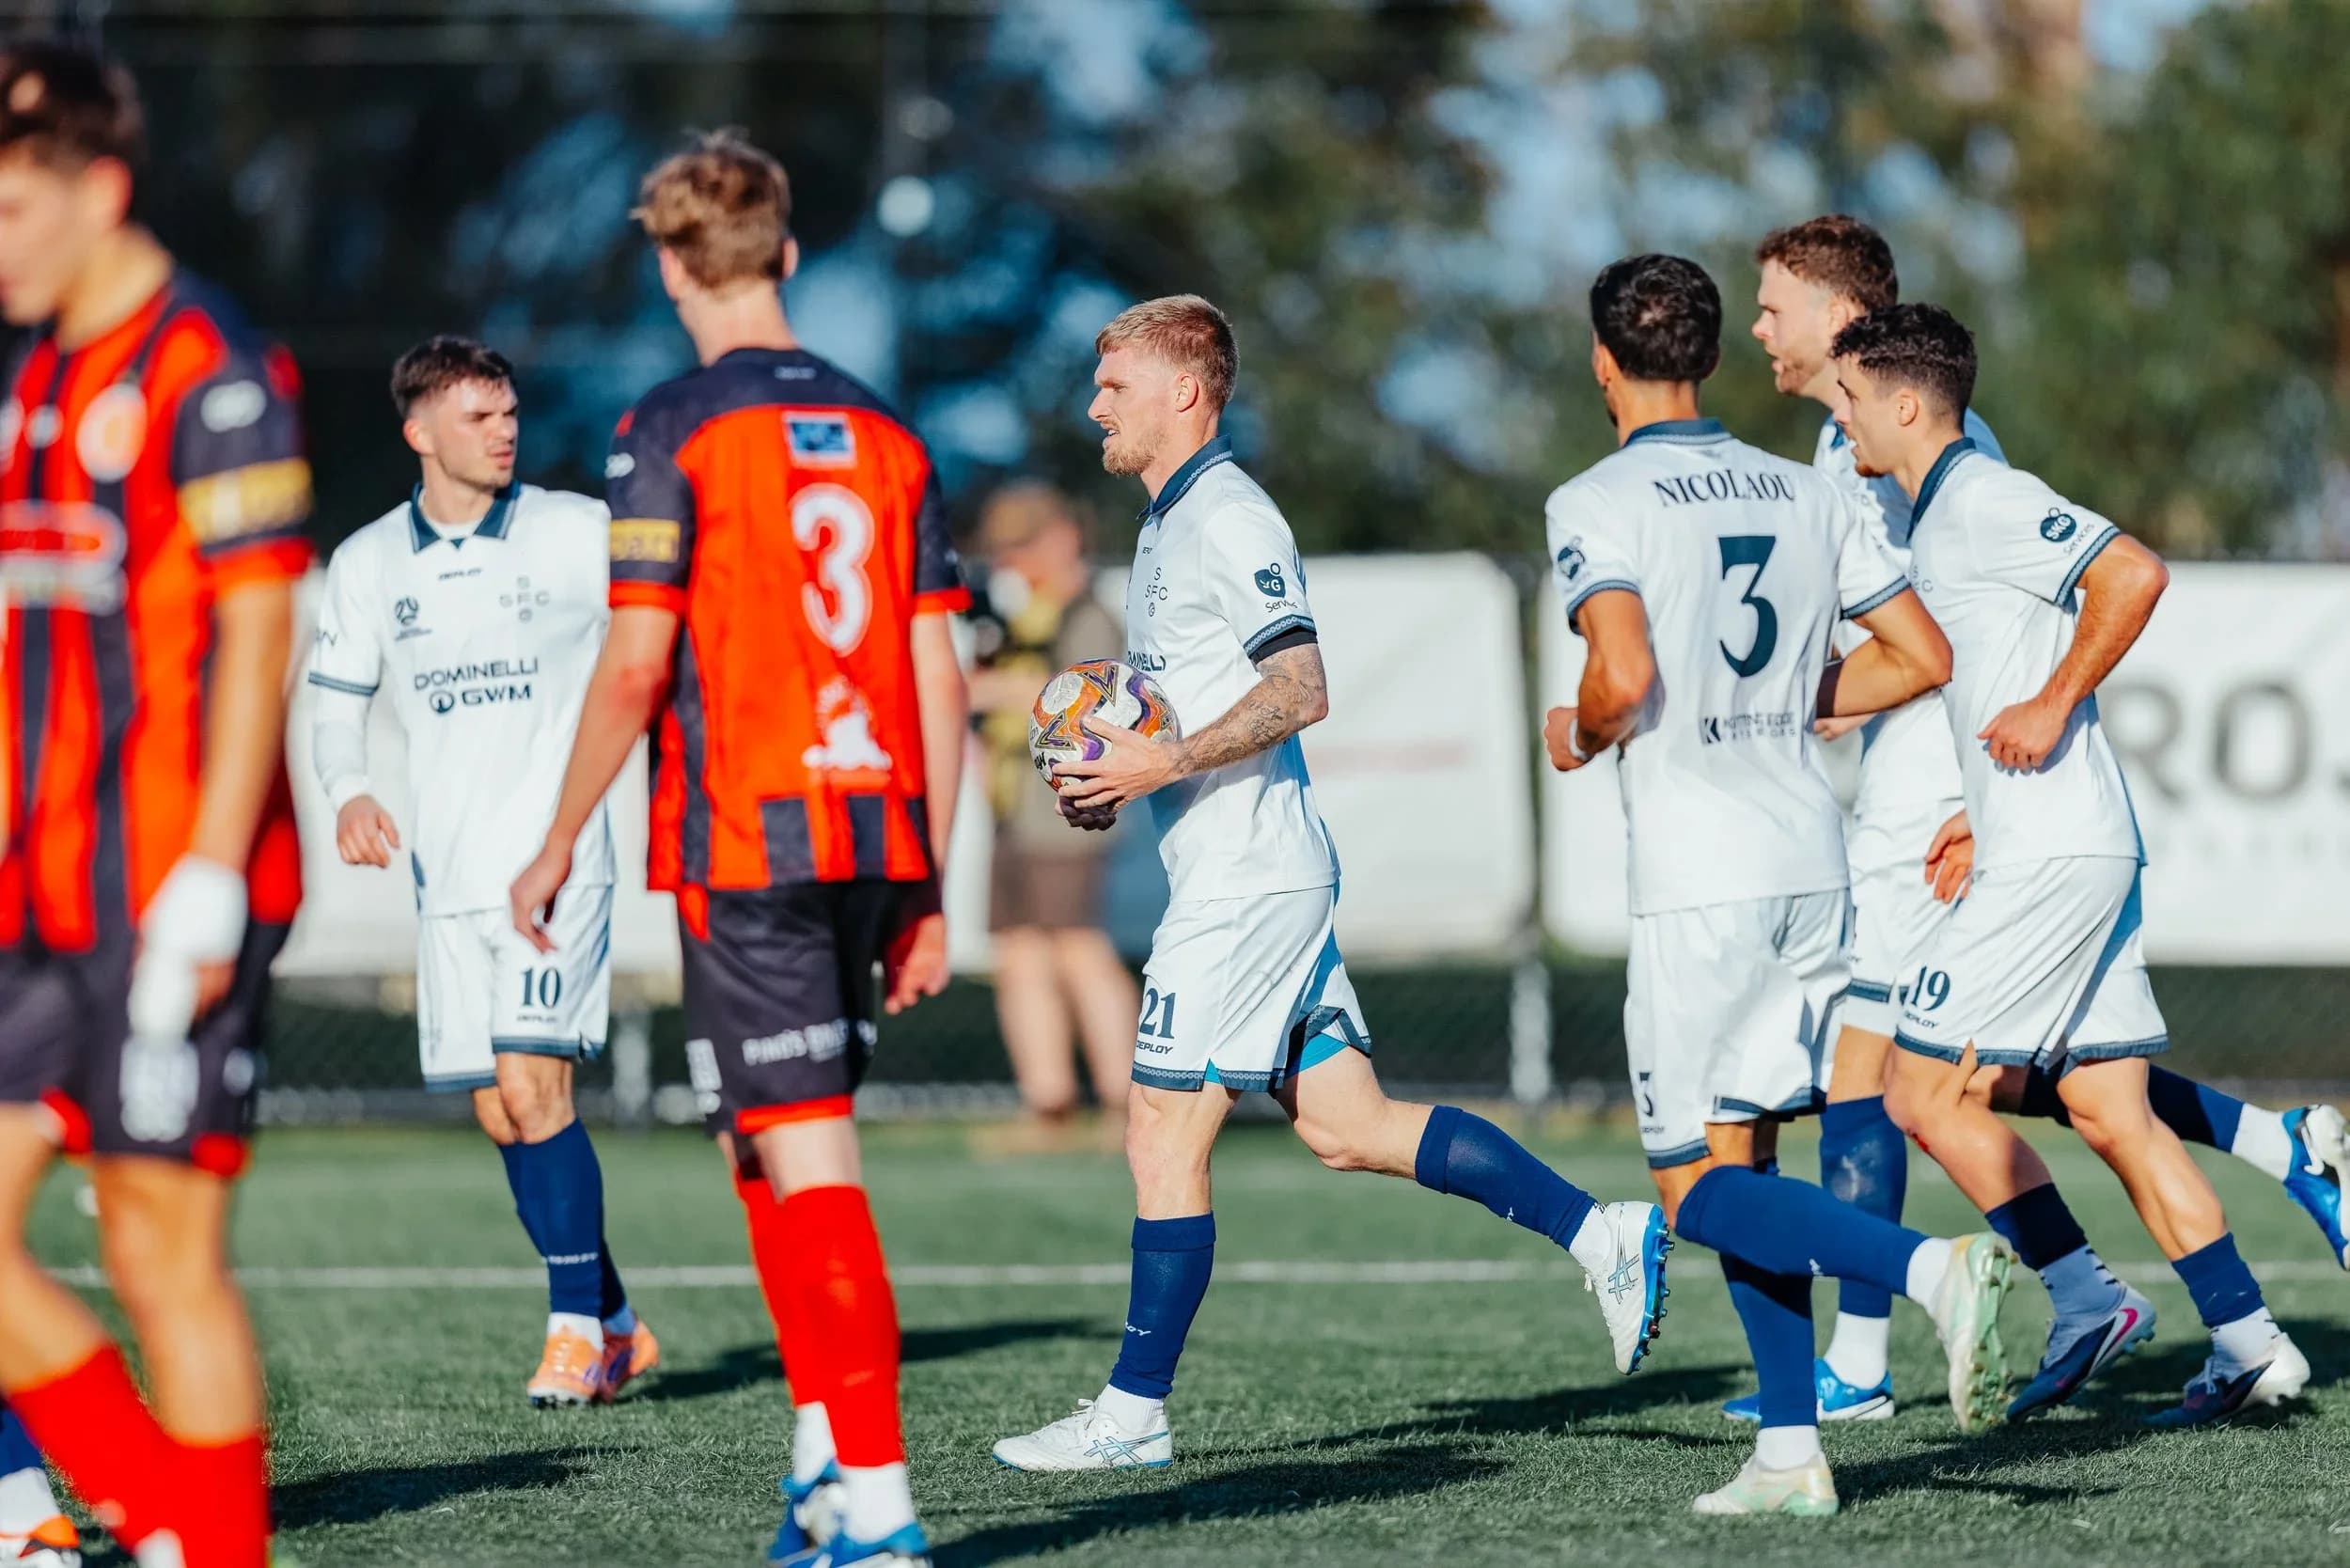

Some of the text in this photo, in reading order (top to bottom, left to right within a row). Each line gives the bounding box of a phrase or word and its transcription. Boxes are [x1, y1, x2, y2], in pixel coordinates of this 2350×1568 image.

[1652, 468, 1796, 507] NICOLAOU
[788, 481, 875, 658] 3
[1717, 535, 1778, 678] 3
[414, 656, 539, 691] DOMINELLI
[462, 683, 533, 706] GWM
[2098, 675, 2350, 808] RO
[520, 966, 561, 1009] 10
[1910, 964, 1951, 1012] 19
[1139, 987, 1177, 1040] 21
